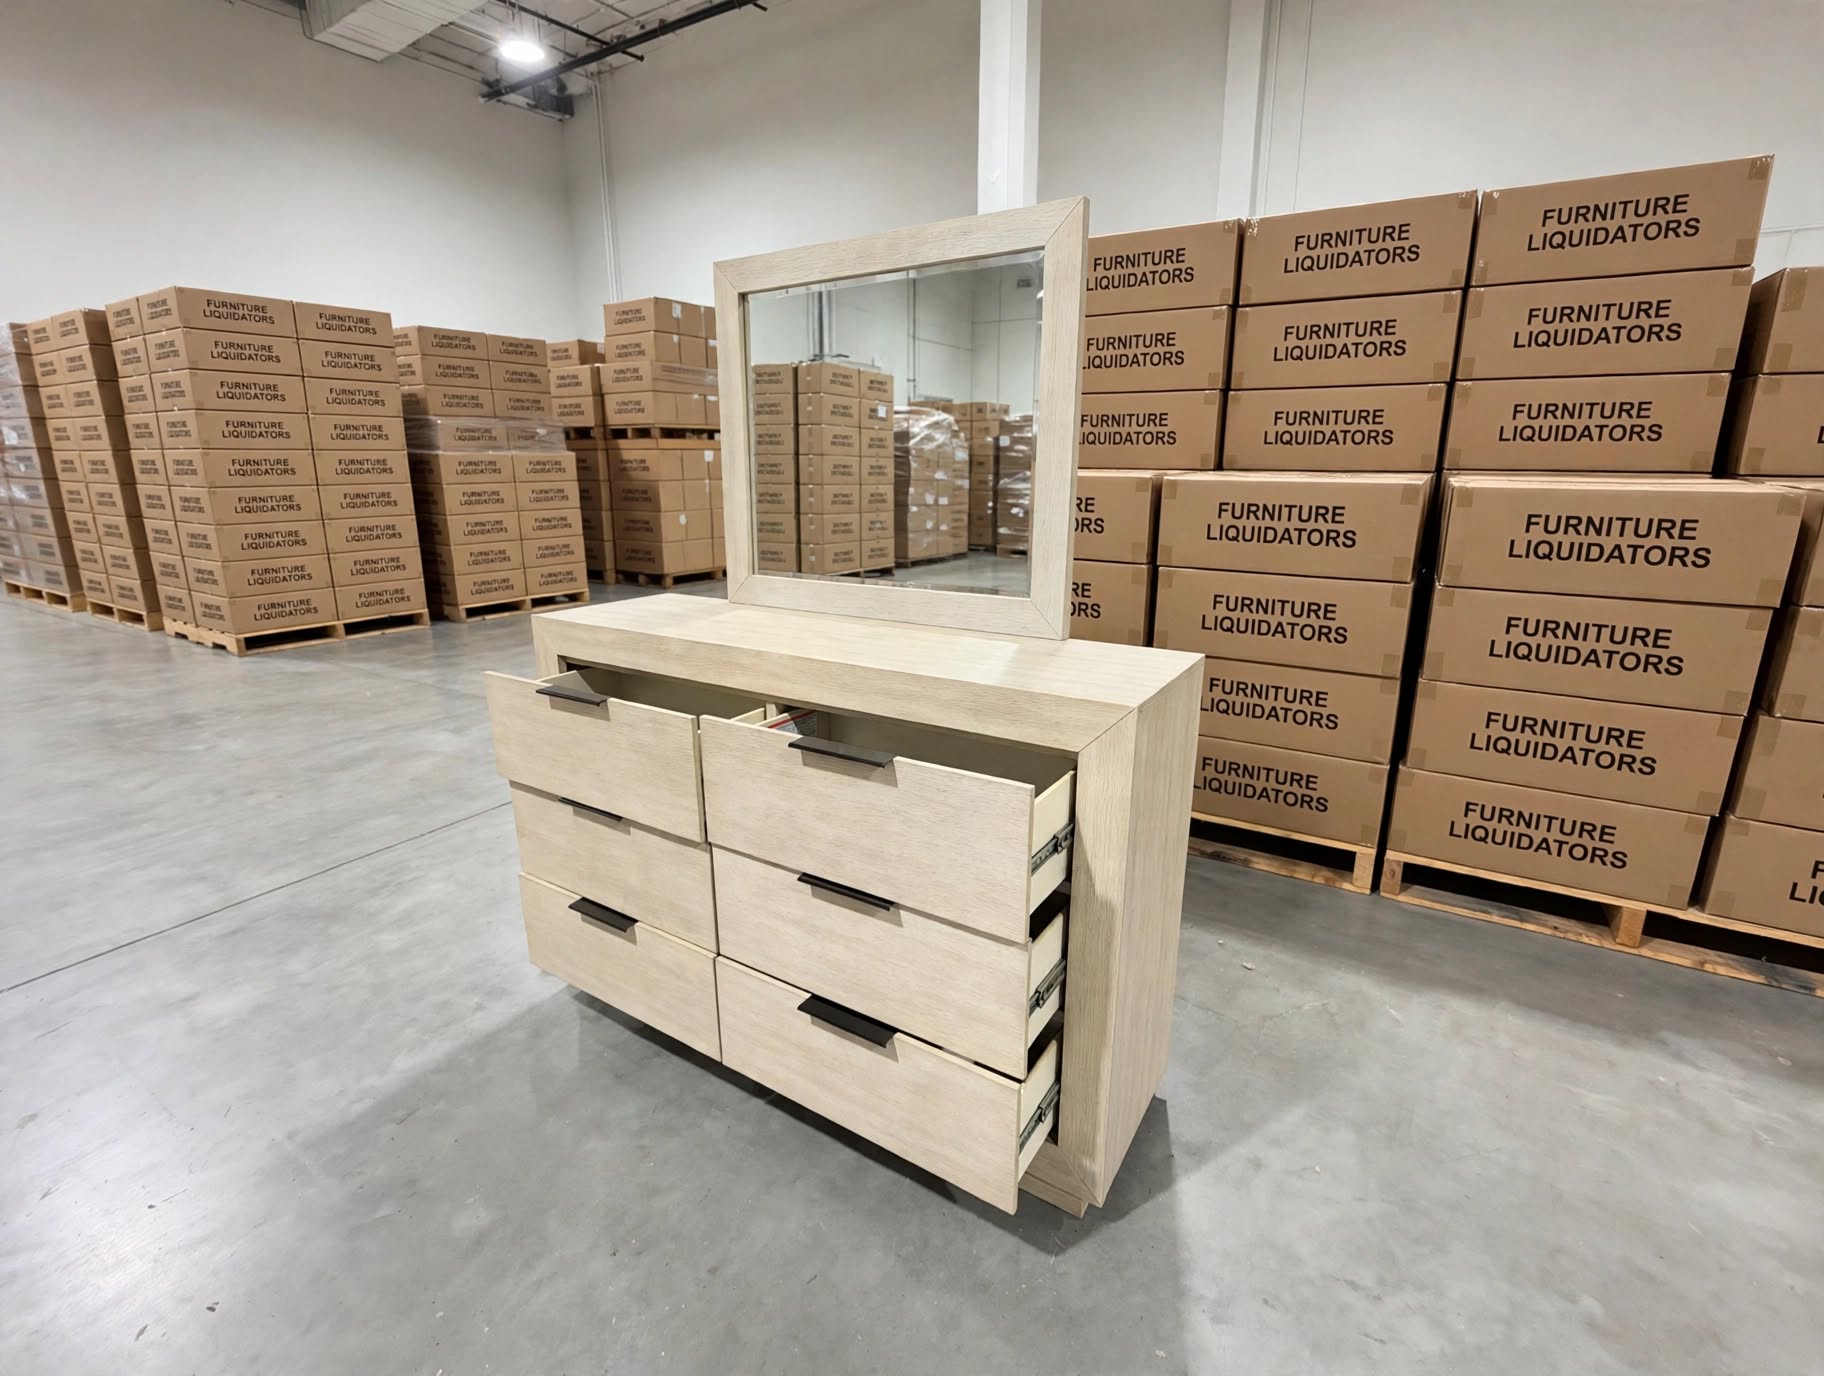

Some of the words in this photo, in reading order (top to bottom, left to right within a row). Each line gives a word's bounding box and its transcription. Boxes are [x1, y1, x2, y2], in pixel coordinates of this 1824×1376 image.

[1541, 193, 1689, 227] FURNITURE
[1294, 222, 1411, 252] FURNITURE
[1527, 217, 1700, 251] LIQUIDATORS
[1093, 247, 1186, 272] FURNITURE
[1283, 243, 1420, 273] LIQUIDATORS
[1085, 266, 1194, 291] LIQUIDATORS
[205, 298, 268, 314] FURNITURE
[1526, 298, 1672, 325] FURNITURE
[202, 308, 275, 324] LIQUIDATORS
[318, 311, 370, 325] FURNITURE
[315, 320, 377, 335] LIQUIDATORS
[1283, 318, 1397, 341] FURNITURE
[1512, 322, 1682, 348] LIQUIDATORS
[213, 339, 273, 353] FURNITURE
[1086, 331, 1176, 352] FURNITURE
[210, 350, 281, 363] LIQUIDATORS
[324, 350, 375, 362] FURNITURE
[1272, 339, 1406, 362] LIQUIDATORS
[320, 359, 382, 371] LIQUIDATORS
[1082, 349, 1184, 370] IQUIDATORS
[219, 380, 279, 392] FURNITURE
[328, 387, 380, 398] FURNITURE
[215, 390, 286, 402] LIQUIDATORS
[325, 396, 386, 407] LIQUIDATORS
[1273, 408, 1384, 426] FURNITURE
[1511, 400, 1653, 420] FURNITURE
[224, 419, 284, 429] FURNITURE
[333, 423, 383, 432] FURNITURE
[1080, 412, 1168, 428] FURNITURE
[221, 428, 291, 439] LIQUIDATORS
[330, 432, 389, 440] LIQUIDATORS
[1078, 430, 1176, 445] IQUIDATORS
[1263, 428, 1393, 446] LIQUIDATORS
[1498, 423, 1663, 442] LIQUIDATORS
[231, 457, 289, 467] FURNITURE
[337, 458, 388, 467] FURNITURE
[227, 466, 296, 477] LIQUIDATORS
[334, 466, 394, 475] LIQUIDATORS
[237, 494, 295, 504] FURNITURE
[342, 491, 392, 500] FURNITURE
[233, 503, 301, 514] LIQUIDATORS
[339, 499, 398, 509] LIQUIDATORS
[1217, 501, 1345, 524] FURNITURE
[348, 523, 396, 533] FURNITURE
[1524, 513, 1699, 540] FURNITURE
[243, 529, 300, 541] FURNITURE
[345, 531, 402, 543] LIQUIDATORS
[1205, 523, 1356, 548] LIQUIDATORS
[240, 537, 307, 550] LIQUIDATORS
[353, 556, 400, 566] FURNITURE
[1507, 538, 1711, 568] LIQUIDATORS
[250, 564, 306, 576] FURNITURE
[349, 563, 406, 576] LIQUIDATORS
[246, 572, 312, 586] LIQUIDATORS
[358, 587, 405, 599] FURNITURE
[256, 597, 311, 611] FURNITURE
[354, 594, 411, 609] LIQUIDATORS
[1212, 593, 1337, 621] FURNITURE
[253, 605, 318, 622] LIQUIDATORS
[1200, 613, 1347, 644] LIQUIDATORS
[1504, 616, 1672, 649] FURNITURE
[1488, 639, 1684, 676] LIQUIDATORS
[1208, 676, 1328, 708] FURNITURE
[1484, 711, 1646, 750] FURNITURE
[1468, 732, 1656, 776] LIQUIDATORS
[1201, 756, 1319, 791] FURNITURE
[1193, 775, 1329, 813] IQUIDATORS
[1462, 800, 1618, 845] FURNITURE
[1447, 820, 1629, 870] LIQUIDATORS
